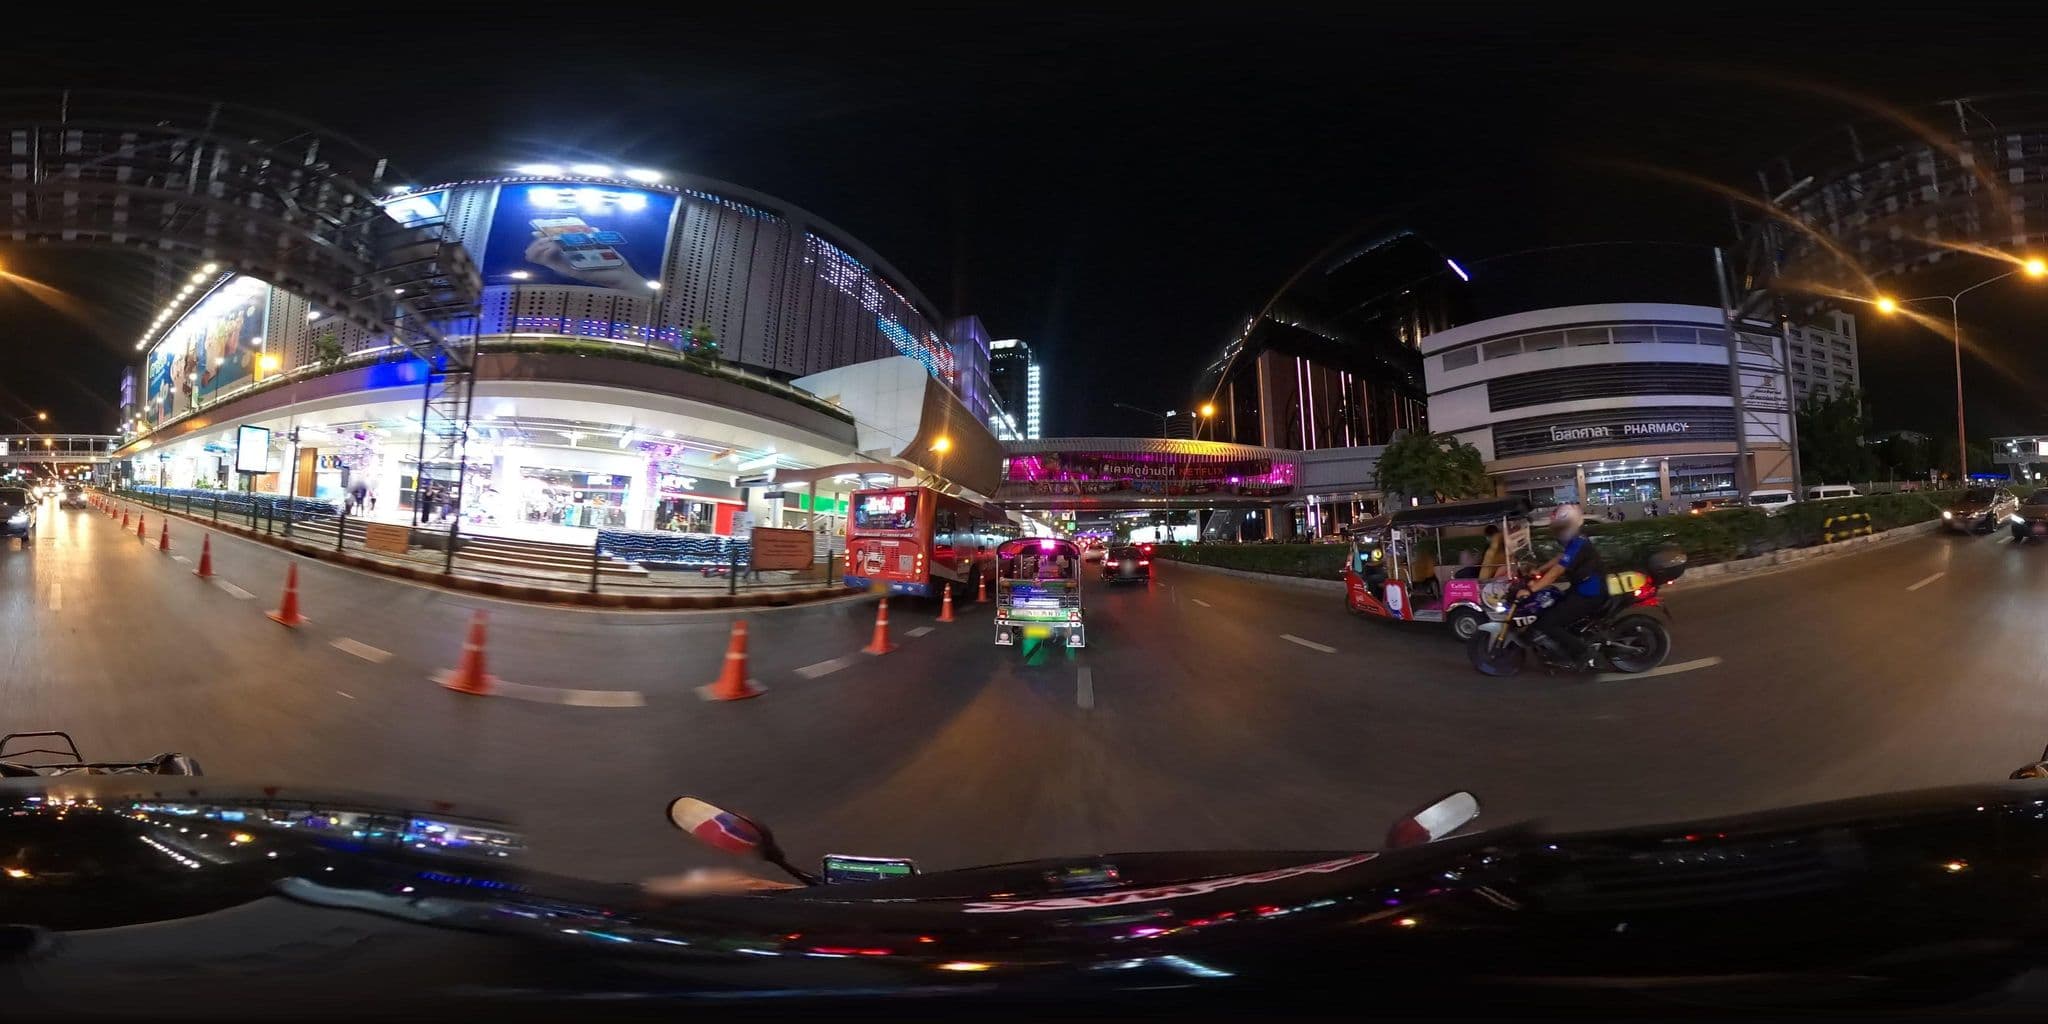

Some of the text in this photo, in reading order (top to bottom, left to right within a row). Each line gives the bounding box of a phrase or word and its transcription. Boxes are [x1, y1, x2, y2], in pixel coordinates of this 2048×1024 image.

[1550, 422, 1687, 441] โอสถศาลา PHARMACY
